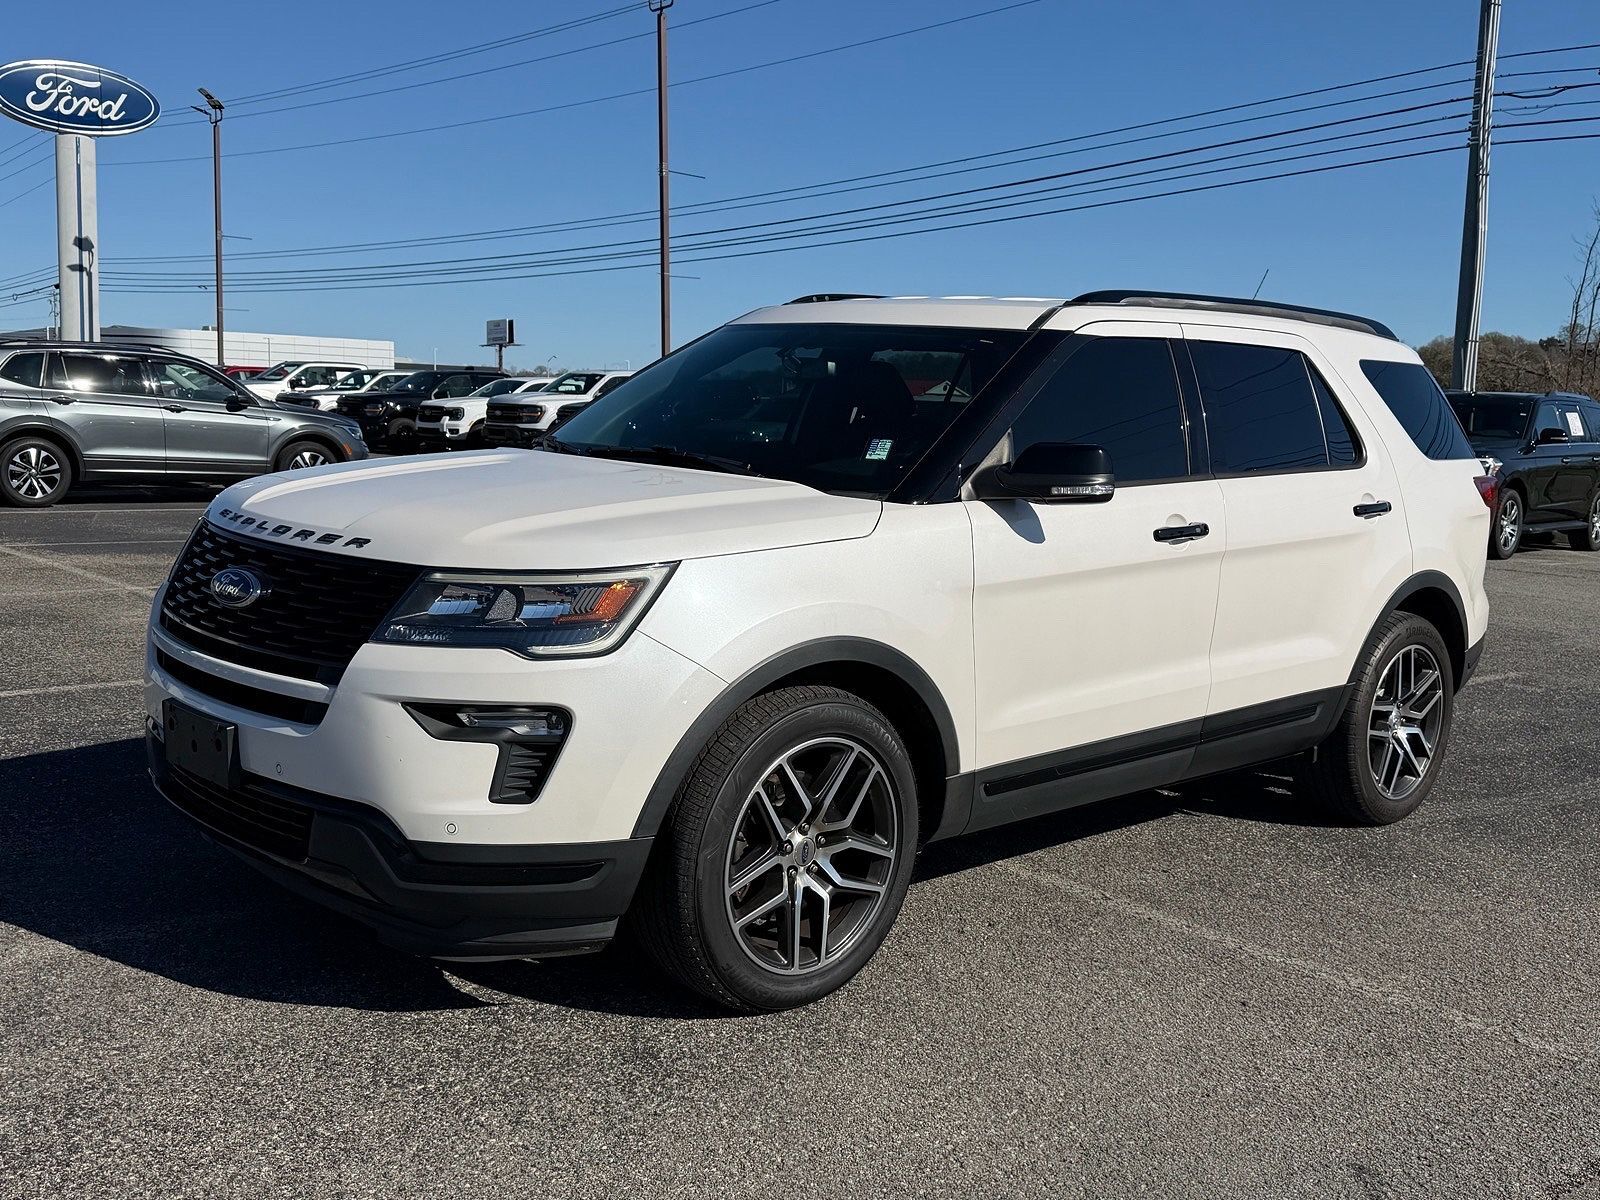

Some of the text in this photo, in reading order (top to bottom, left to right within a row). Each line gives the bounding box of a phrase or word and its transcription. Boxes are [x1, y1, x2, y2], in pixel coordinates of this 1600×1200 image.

[26, 73, 128, 121] Ford
[219, 508, 372, 548] EXPLORER
[215, 573, 244, 597] Ford
